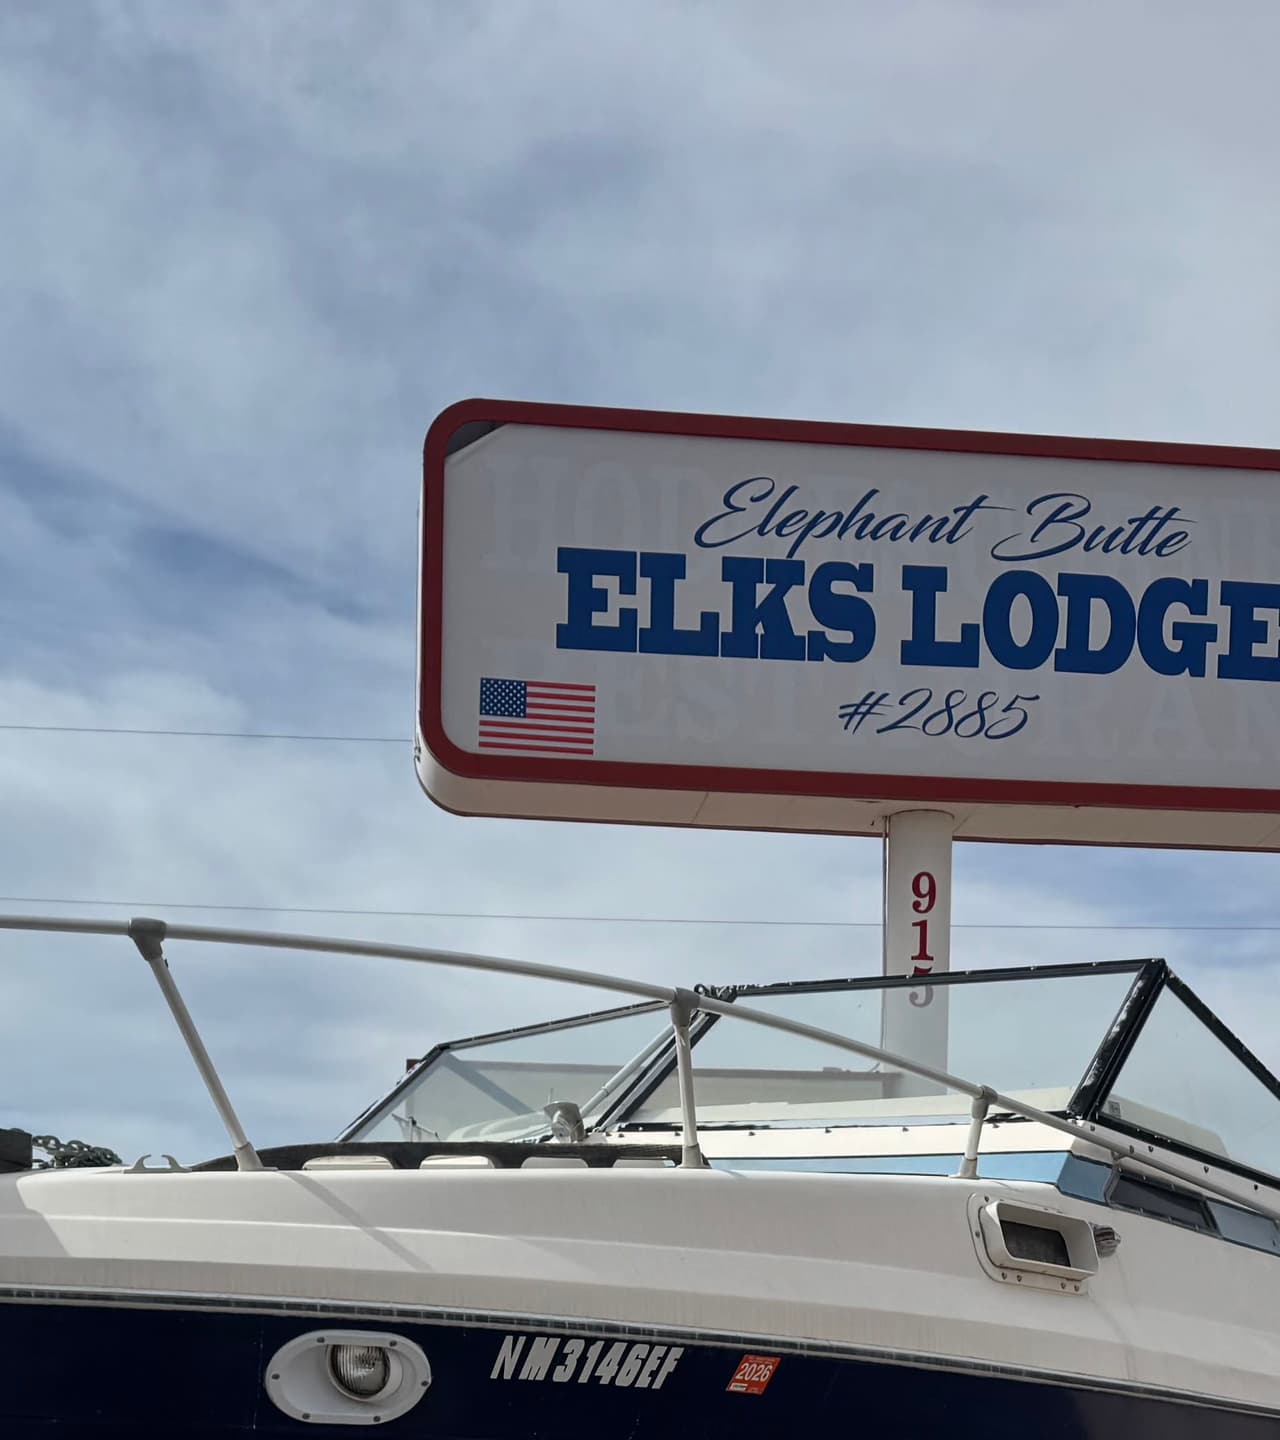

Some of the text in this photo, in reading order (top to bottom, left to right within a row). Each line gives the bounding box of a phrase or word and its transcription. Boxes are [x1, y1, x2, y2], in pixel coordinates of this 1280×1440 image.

[694, 476, 1016, 559] Elephant
[990, 492, 1198, 562] Butte
[556, 546, 877, 663] ELKS
[838, 687, 1041, 740] #2885
[735, 1362, 774, 1383] 2026
